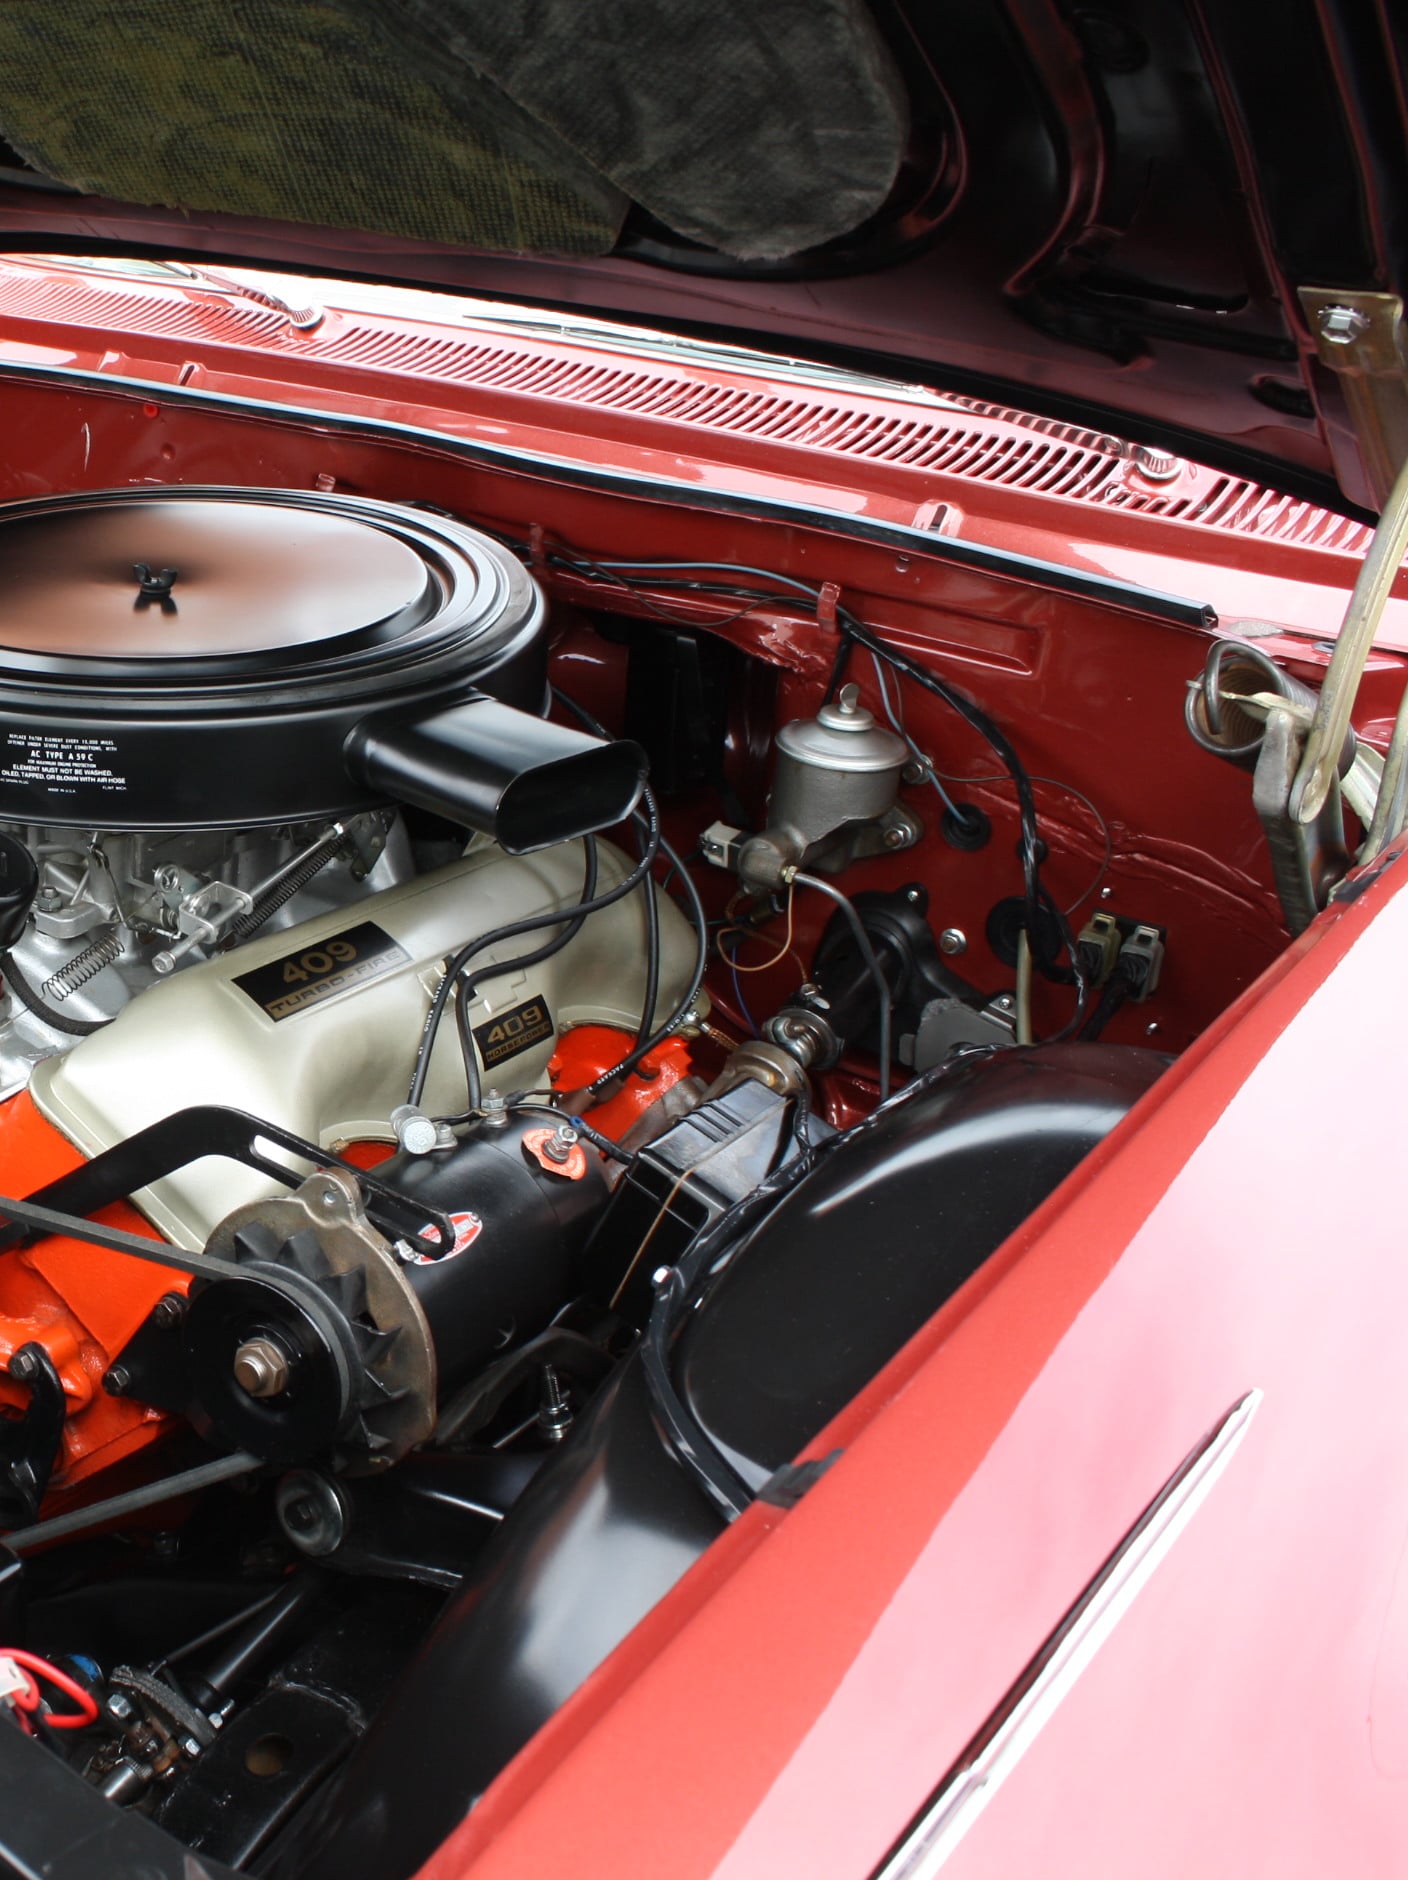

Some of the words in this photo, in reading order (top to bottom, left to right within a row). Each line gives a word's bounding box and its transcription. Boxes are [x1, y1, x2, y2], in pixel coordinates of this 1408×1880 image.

[30, 750, 41, 758] AC
[45, 751, 64, 760] TYPE
[12, 763, 41, 772] ELEMENT
[41, 766, 59, 774] MUST
[108, 777, 126, 785] HOSE
[282, 941, 359, 983] 409
[269, 949, 402, 1012] TURBO-FIRE
[486, 1005, 544, 1046] 409
[596, 1063, 625, 1085] PACKARD
